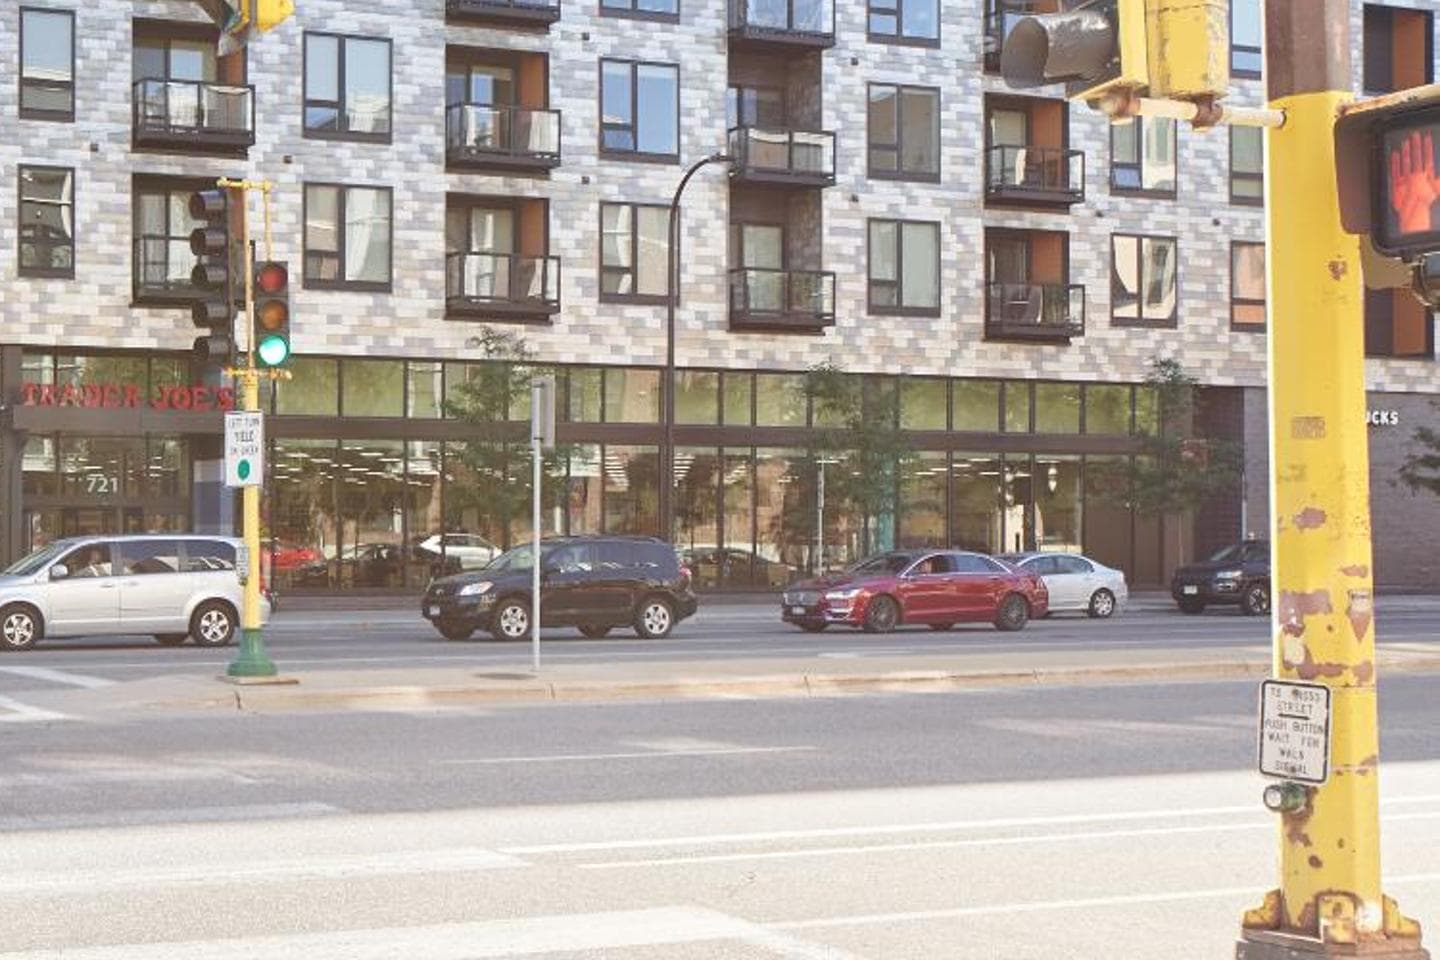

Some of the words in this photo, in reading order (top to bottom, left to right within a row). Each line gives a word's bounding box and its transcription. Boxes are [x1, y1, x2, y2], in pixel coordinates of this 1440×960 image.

[21, 382, 141, 409] TRADER
[86, 477, 119, 493] 721
[1277, 701, 1313, 715] STREET
[1265, 719, 1287, 731] PUSH
[1292, 721, 1324, 735] BUTTON
[1268, 732, 1290, 744] WAIT
[1278, 747, 1305, 761] WALK
